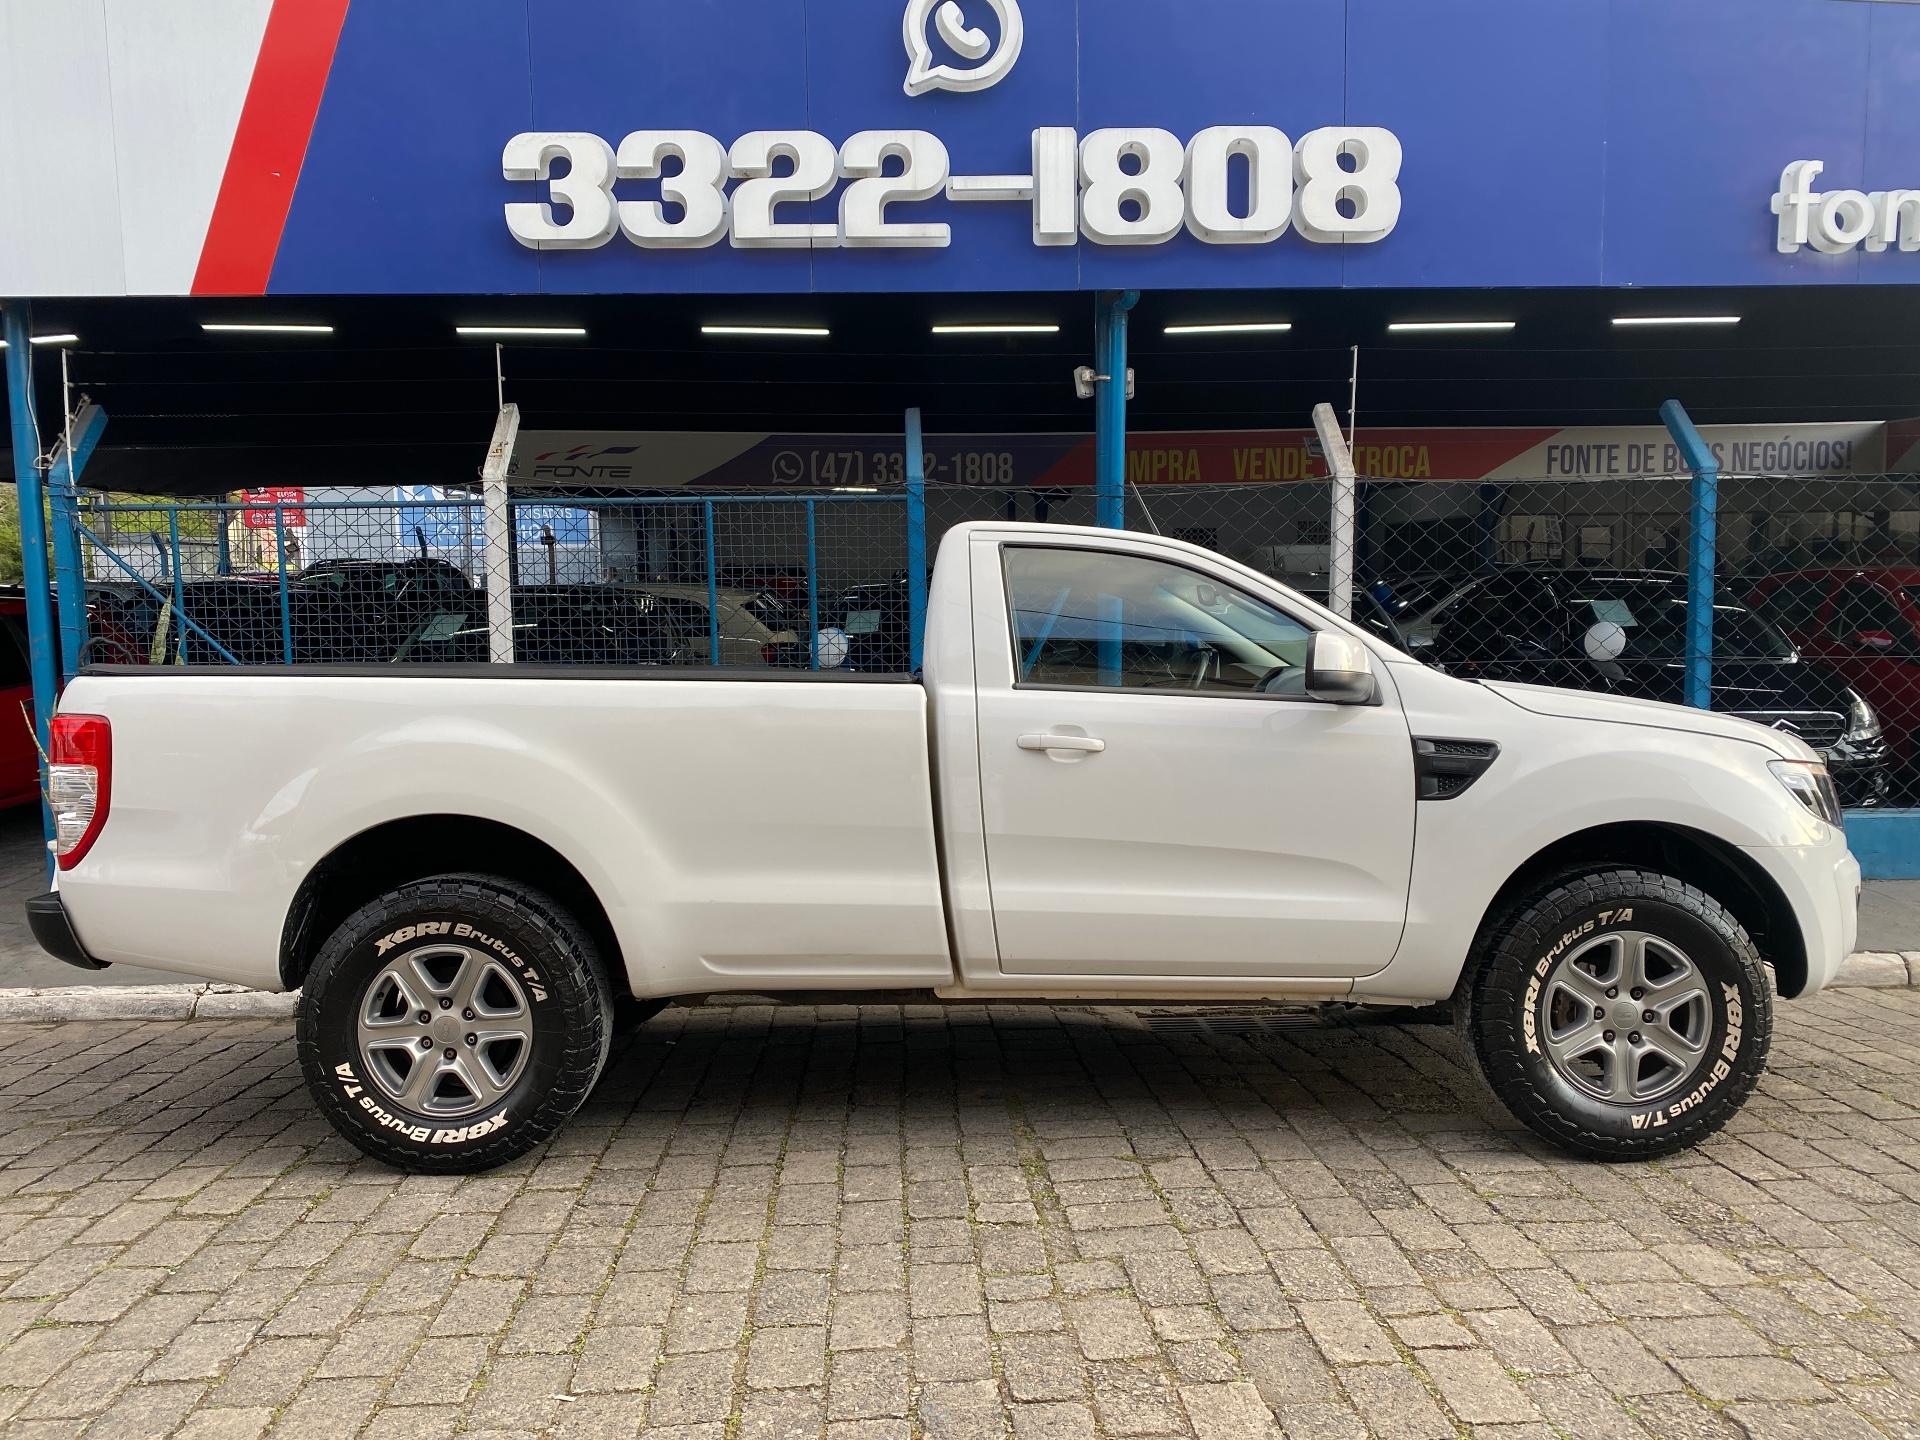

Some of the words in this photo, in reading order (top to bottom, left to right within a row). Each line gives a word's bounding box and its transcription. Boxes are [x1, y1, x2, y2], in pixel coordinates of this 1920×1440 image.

[502, 126, 1402, 249] 3322-1808
[533, 465, 632, 478] FONTE
[810, 450, 864, 485] (47)
[872, 452, 1014, 484] 332-1808
[1232, 447, 1314, 481] VENDE
[1354, 446, 1432, 478] TROCA
[1547, 444, 1620, 475] FONTE
[1627, 443, 1657, 474] DE
[1731, 435, 1853, 472] NEGÓCIOS!
[1536, 919, 1596, 977] Brutus
[1598, 908, 1634, 926] T/A
[453, 923, 527, 969] Brutus
[523, 966, 550, 1004] T/A
[333, 1060, 361, 1100] T/A
[1669, 1058, 1732, 1118] Brutus
[358, 1096, 428, 1142] Brutus
[1630, 1110, 1668, 1131] T/A
